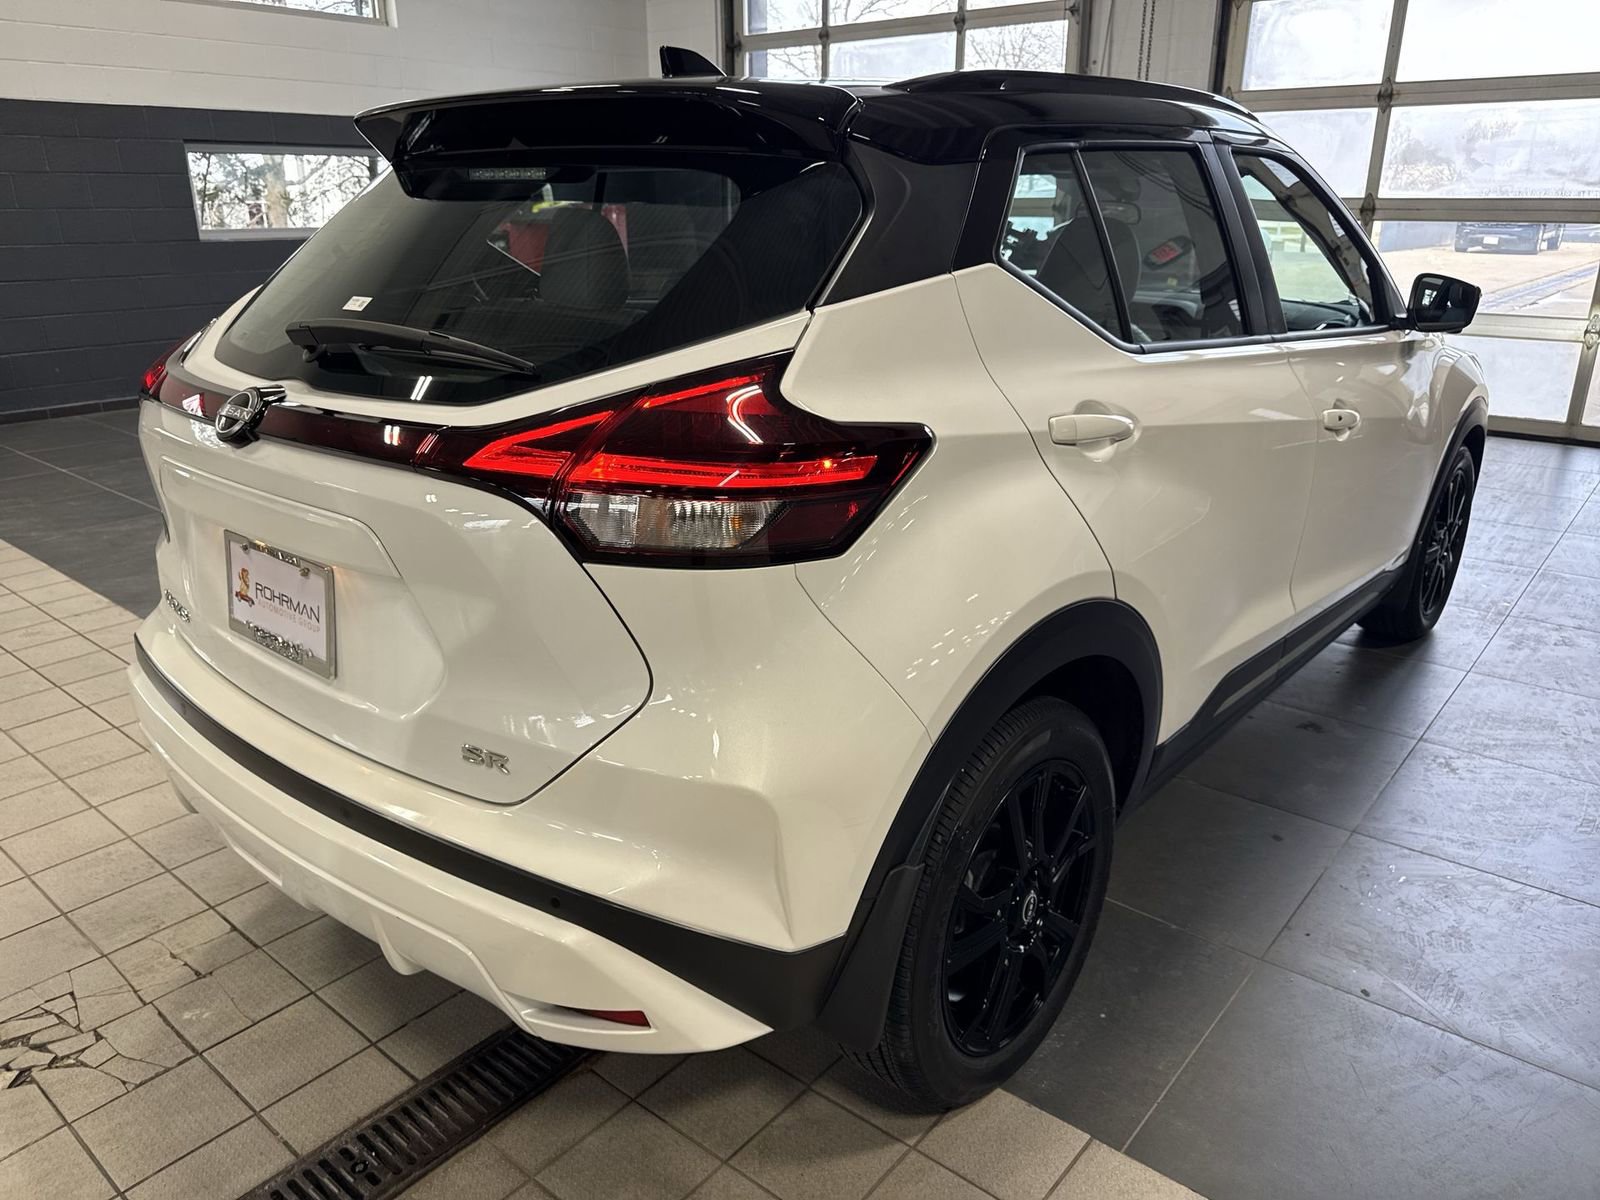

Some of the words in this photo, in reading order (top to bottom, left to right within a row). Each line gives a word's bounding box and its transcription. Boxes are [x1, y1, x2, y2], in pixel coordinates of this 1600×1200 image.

[218, 404, 252, 420] SSAN
[255, 582, 320, 624] ROHRMAN
[257, 599, 297, 624] AUTOMOTIVE
[298, 617, 321, 633] GROUP
[461, 743, 511, 775] SR
